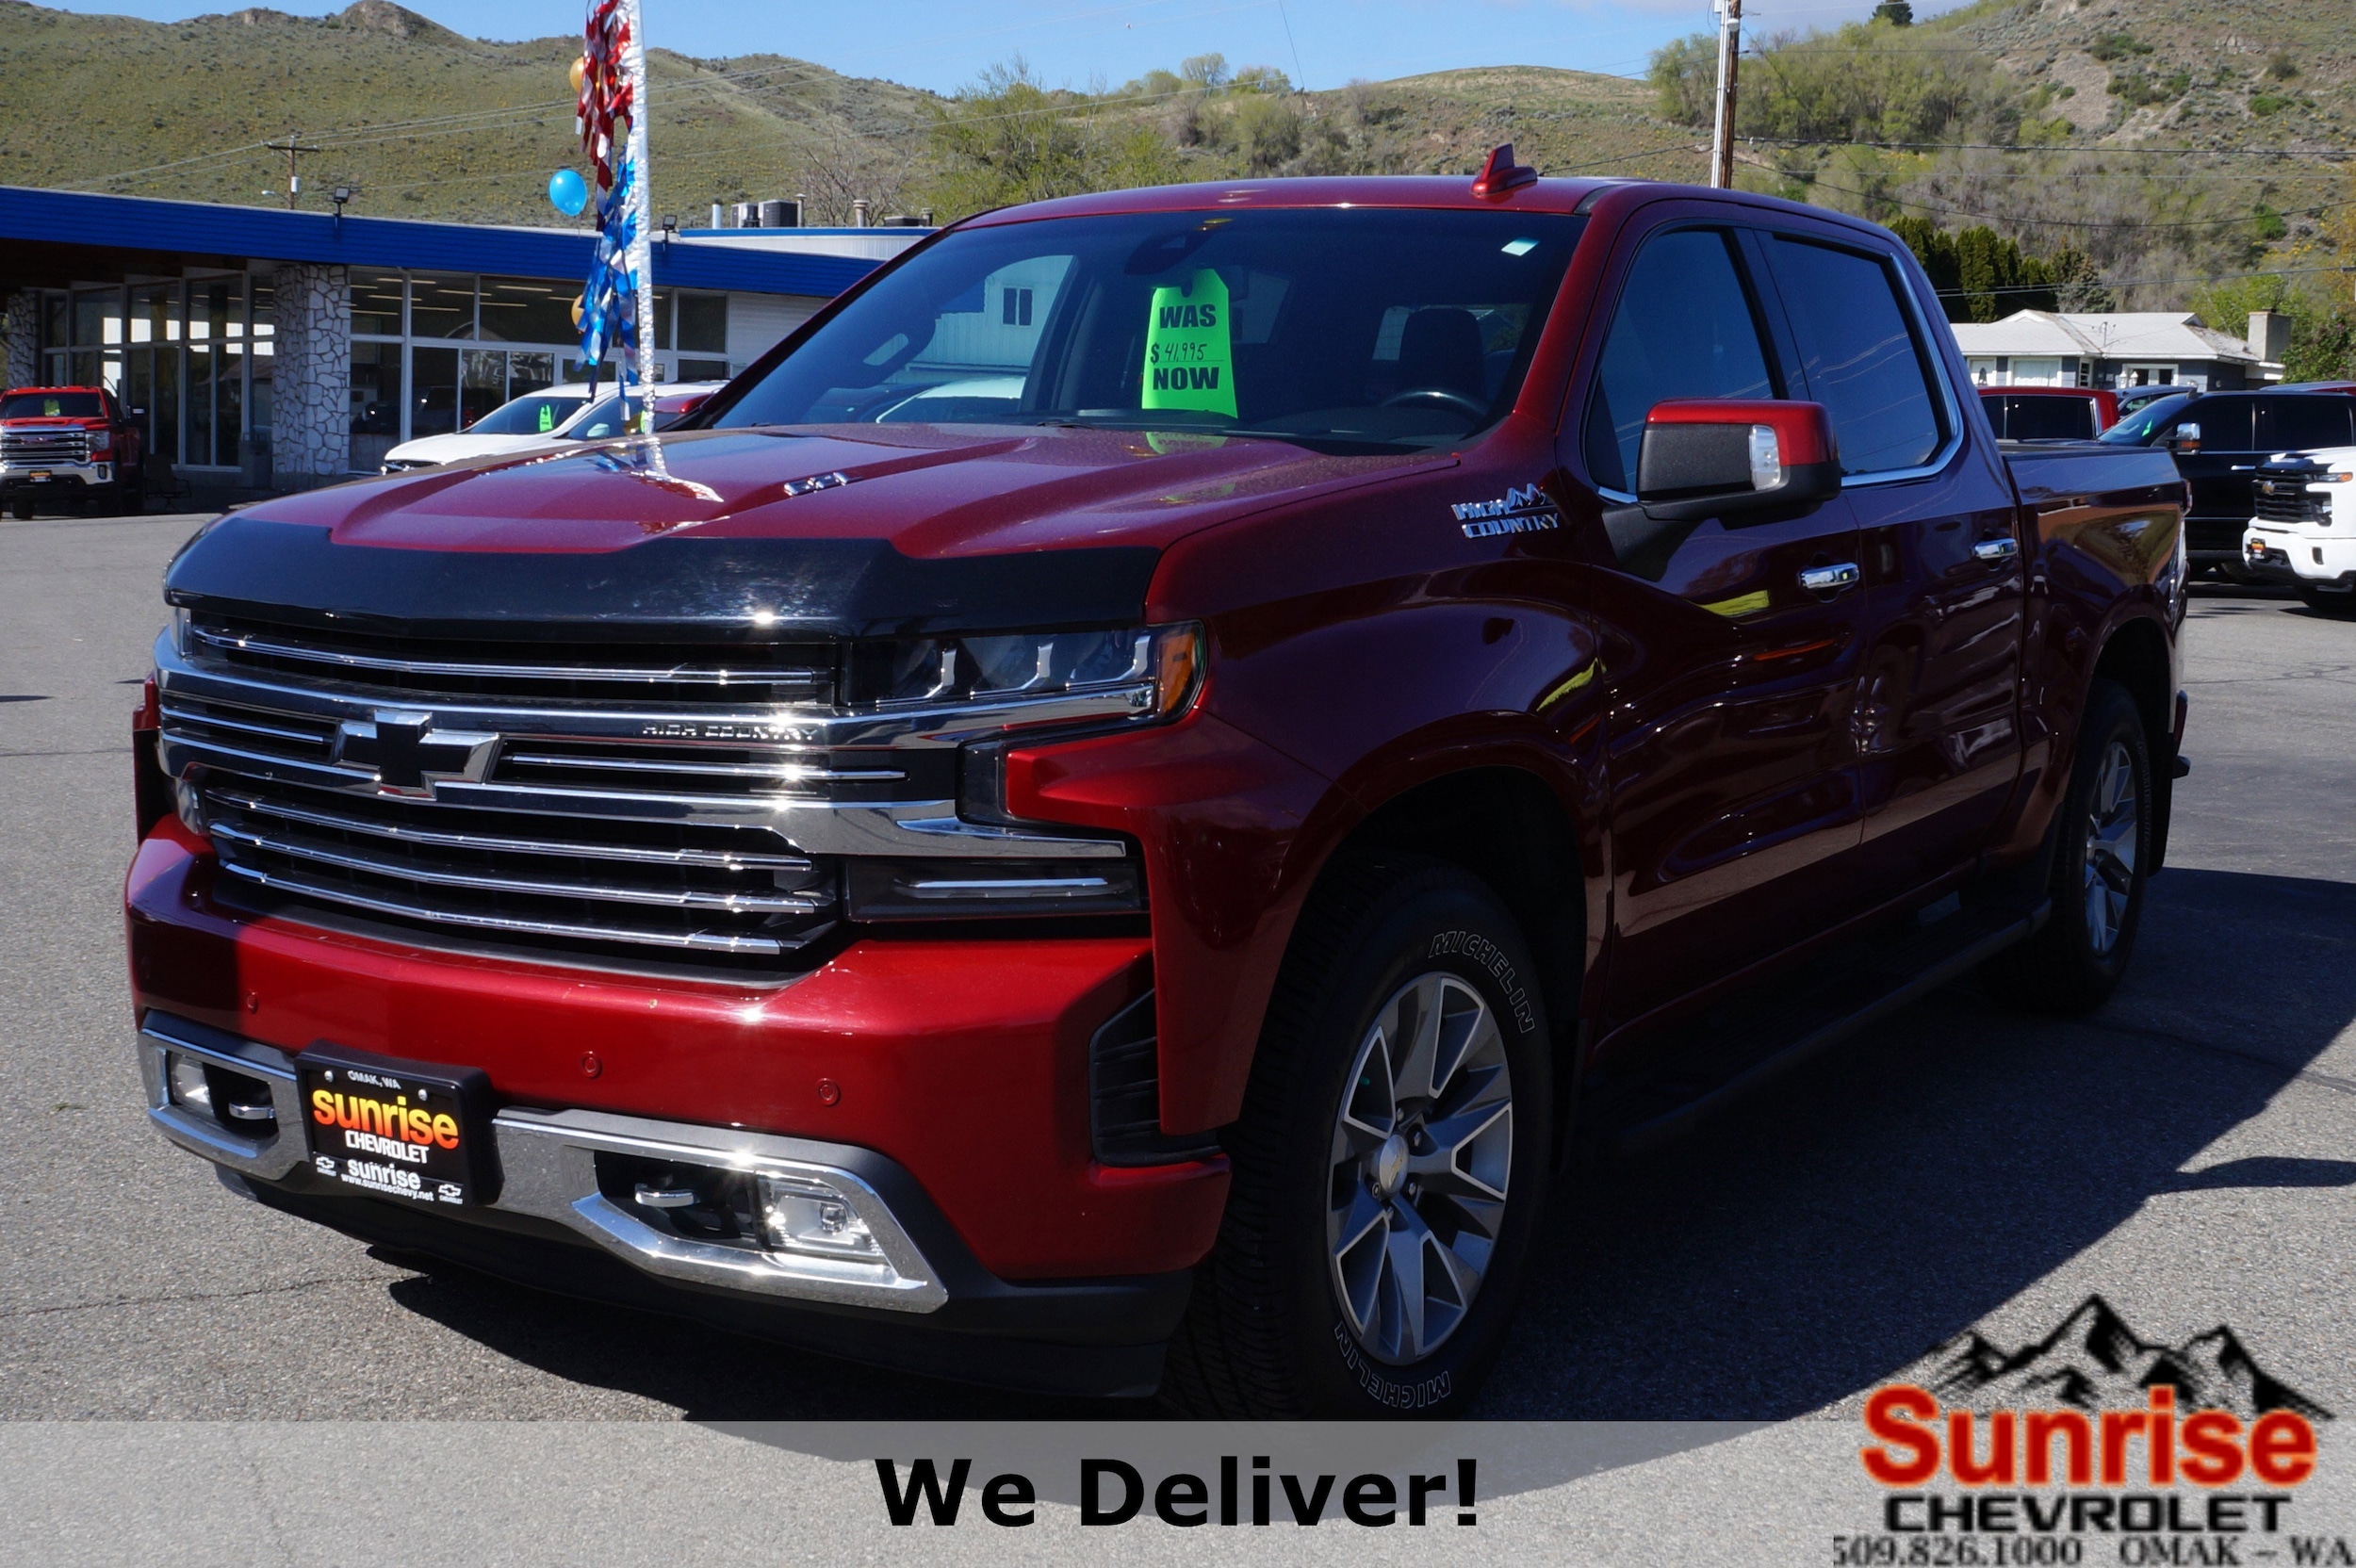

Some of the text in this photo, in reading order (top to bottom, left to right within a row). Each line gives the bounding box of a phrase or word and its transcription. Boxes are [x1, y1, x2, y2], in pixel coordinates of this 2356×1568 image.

[1159, 303, 1217, 329] WAS
[1153, 367, 1219, 390] NOW
[1450, 498, 1512, 521] HIGH
[1462, 513, 1559, 539] COUNTRY
[1428, 930, 1535, 1034] MICHELIN
[347, 1070, 401, 1089] OMAK, WA
[312, 1089, 459, 1150] sunrise
[345, 1130, 430, 1164] CHEVROLET
[347, 1159, 421, 1190] sunrise
[1334, 1321, 1451, 1409] MICHELIN
